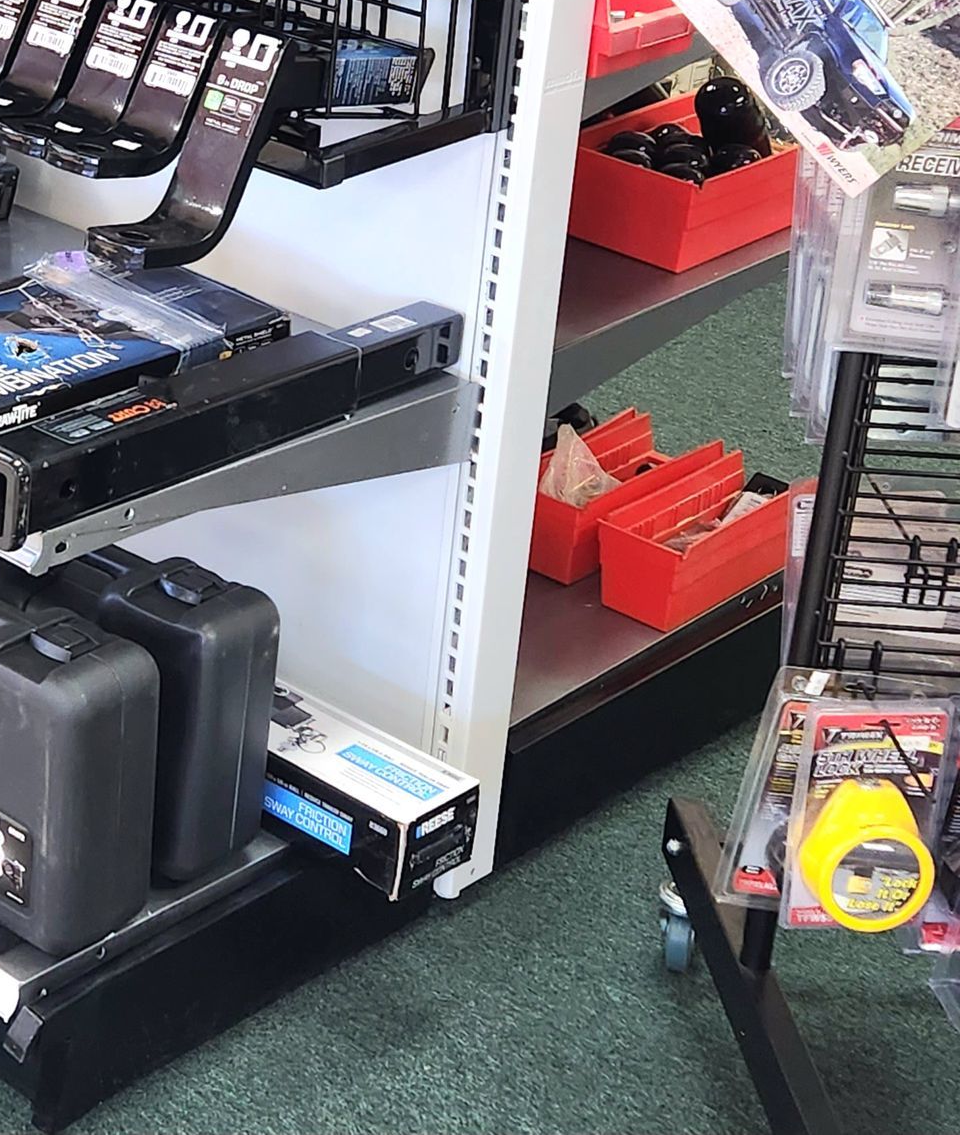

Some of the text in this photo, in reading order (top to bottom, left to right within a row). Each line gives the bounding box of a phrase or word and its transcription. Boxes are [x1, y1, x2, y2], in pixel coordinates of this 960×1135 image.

[264, 796, 295, 819] SWAY
[295, 812, 346, 849] CONTROL
[298, 802, 347, 836] FRICTION
[422, 806, 456, 836] REESE
[848, 898, 880, 912] Lose
